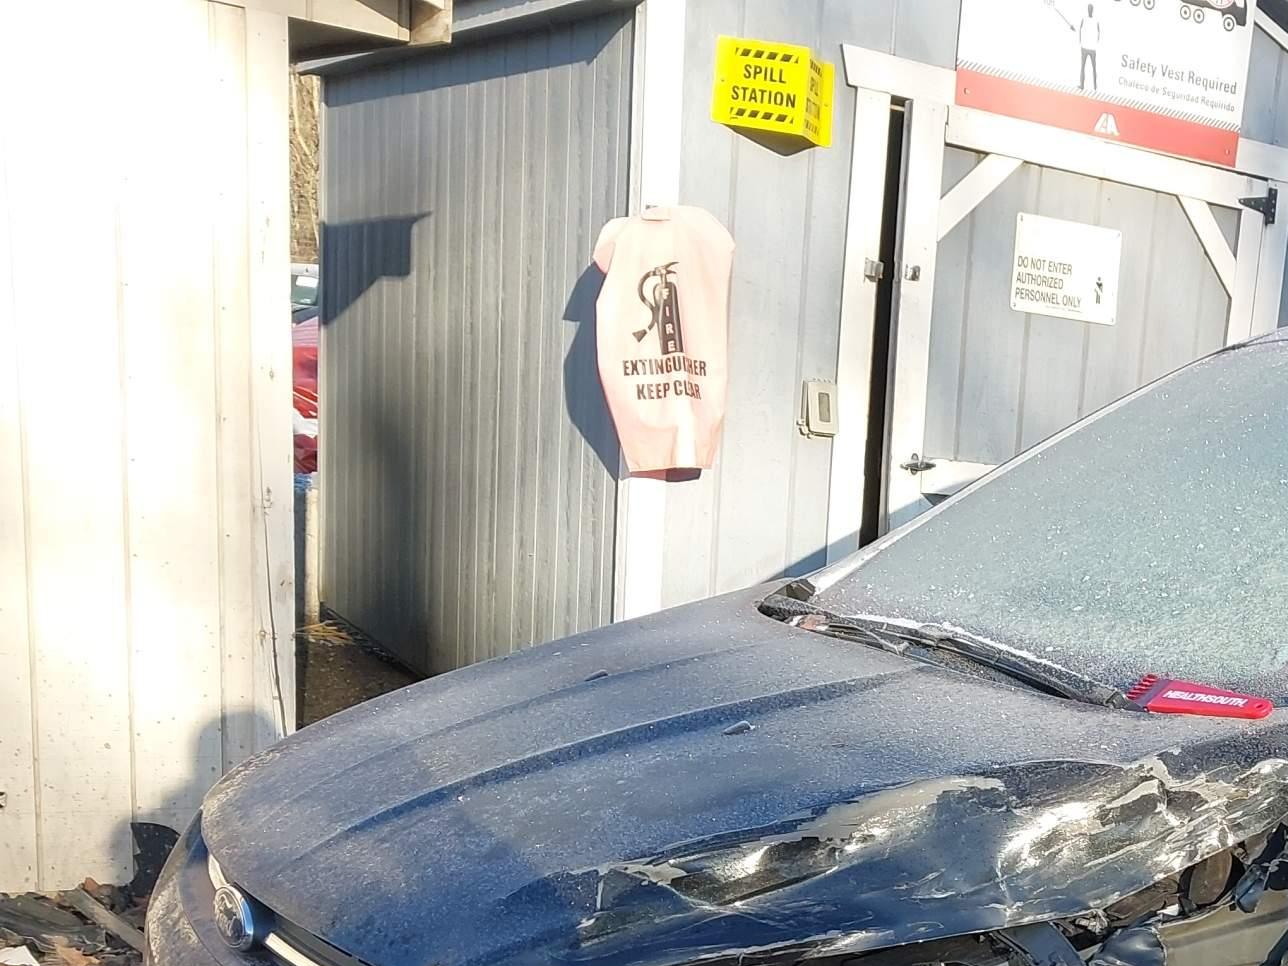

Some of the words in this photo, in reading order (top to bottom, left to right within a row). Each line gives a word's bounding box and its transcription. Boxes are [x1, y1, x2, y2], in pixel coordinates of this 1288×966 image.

[744, 64, 787, 84] SPILL
[1121, 54, 1157, 78] Safety
[1161, 64, 1185, 81] Vest
[1188, 71, 1238, 95] Required
[731, 86, 797, 109] STATION
[1118, 76, 1149, 92] Chaleco
[1162, 87, 1199, 104] Seguridad
[1017, 255, 1029, 269] DO
[1031, 257, 1046, 272] NOT
[1048, 260, 1073, 277] ENTER
[1016, 271, 1064, 290] AUTHORIZED
[1015, 287, 1060, 305] PERSONNEL
[1063, 294, 1081, 308] ONLY
[622, 355, 707, 377] EXTINGUIHER
[636, 382, 670, 401] KEEP
[1162, 690, 1249, 708] HEALTHSOUTH
